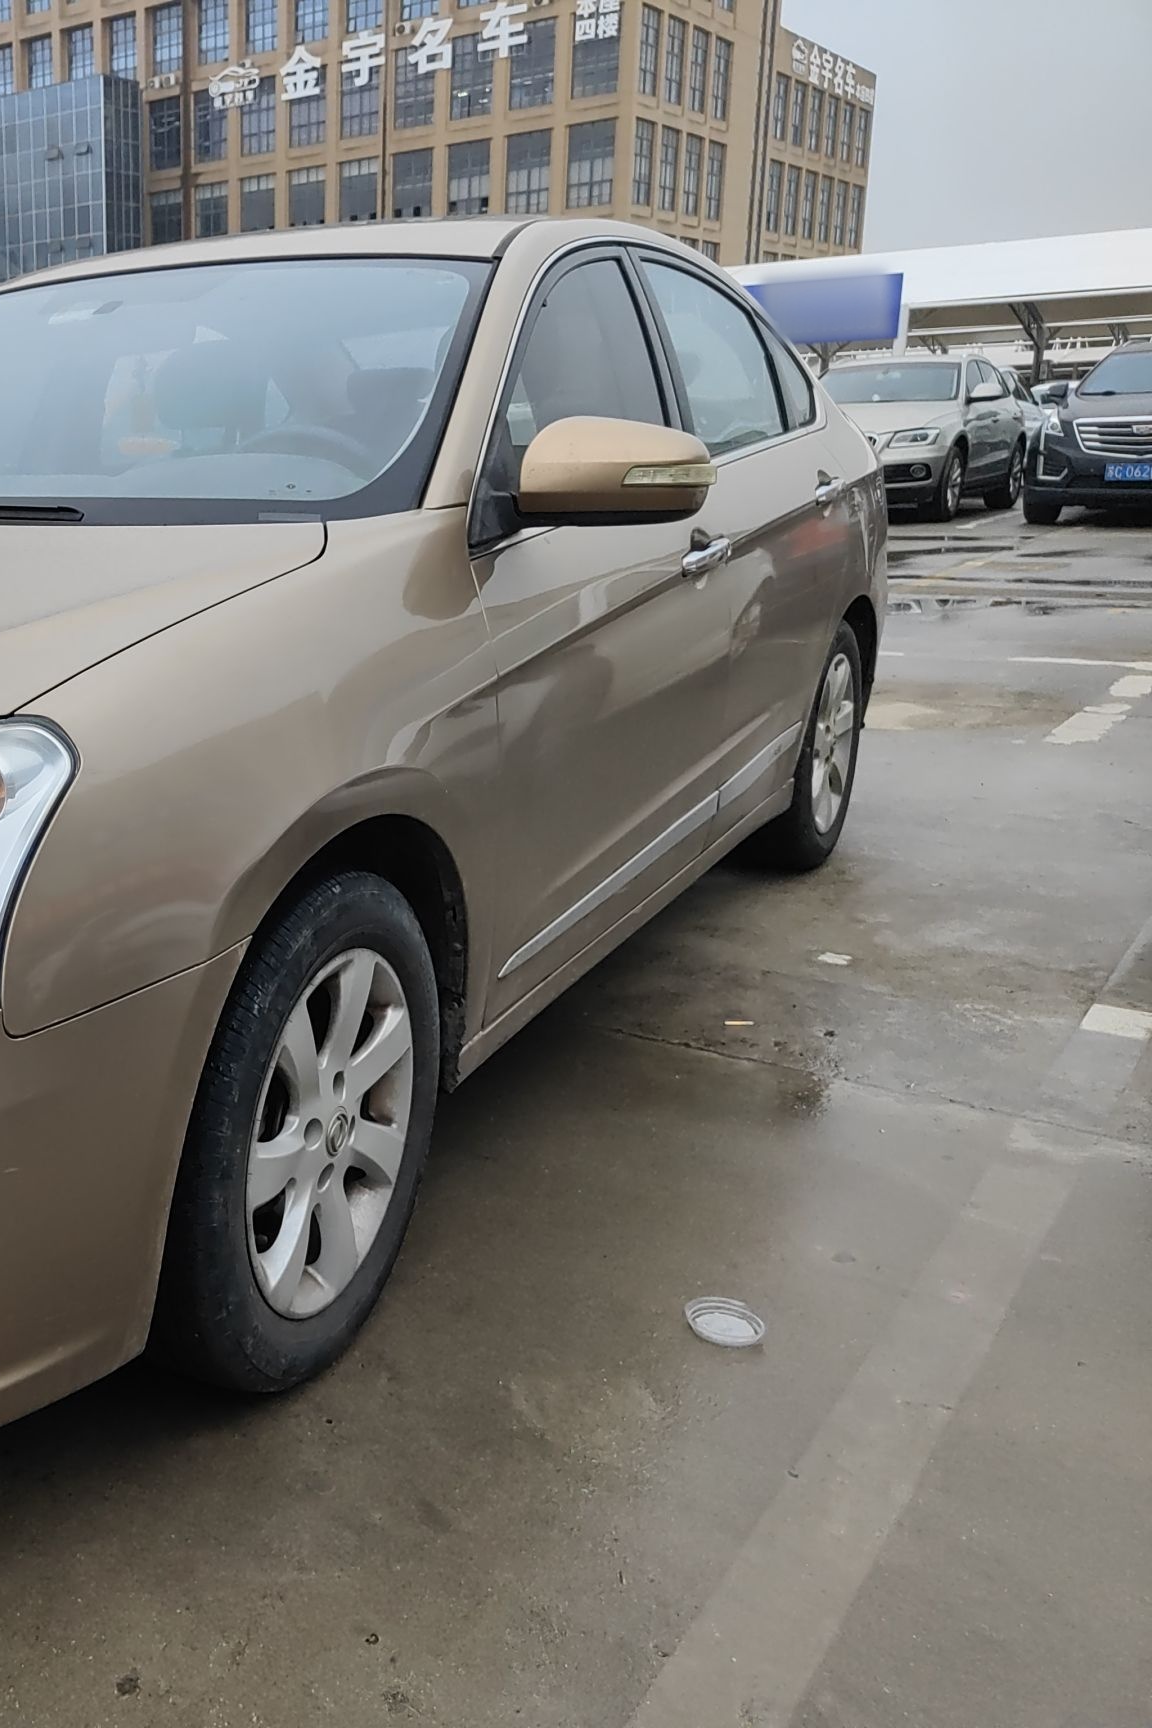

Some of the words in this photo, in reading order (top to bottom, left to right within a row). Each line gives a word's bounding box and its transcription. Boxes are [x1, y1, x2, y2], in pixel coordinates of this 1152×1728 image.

[280, 3, 528, 101] 金宇名车
[575, 13, 618, 41] 四楼
[809, 44, 856, 99] 金宇名车
